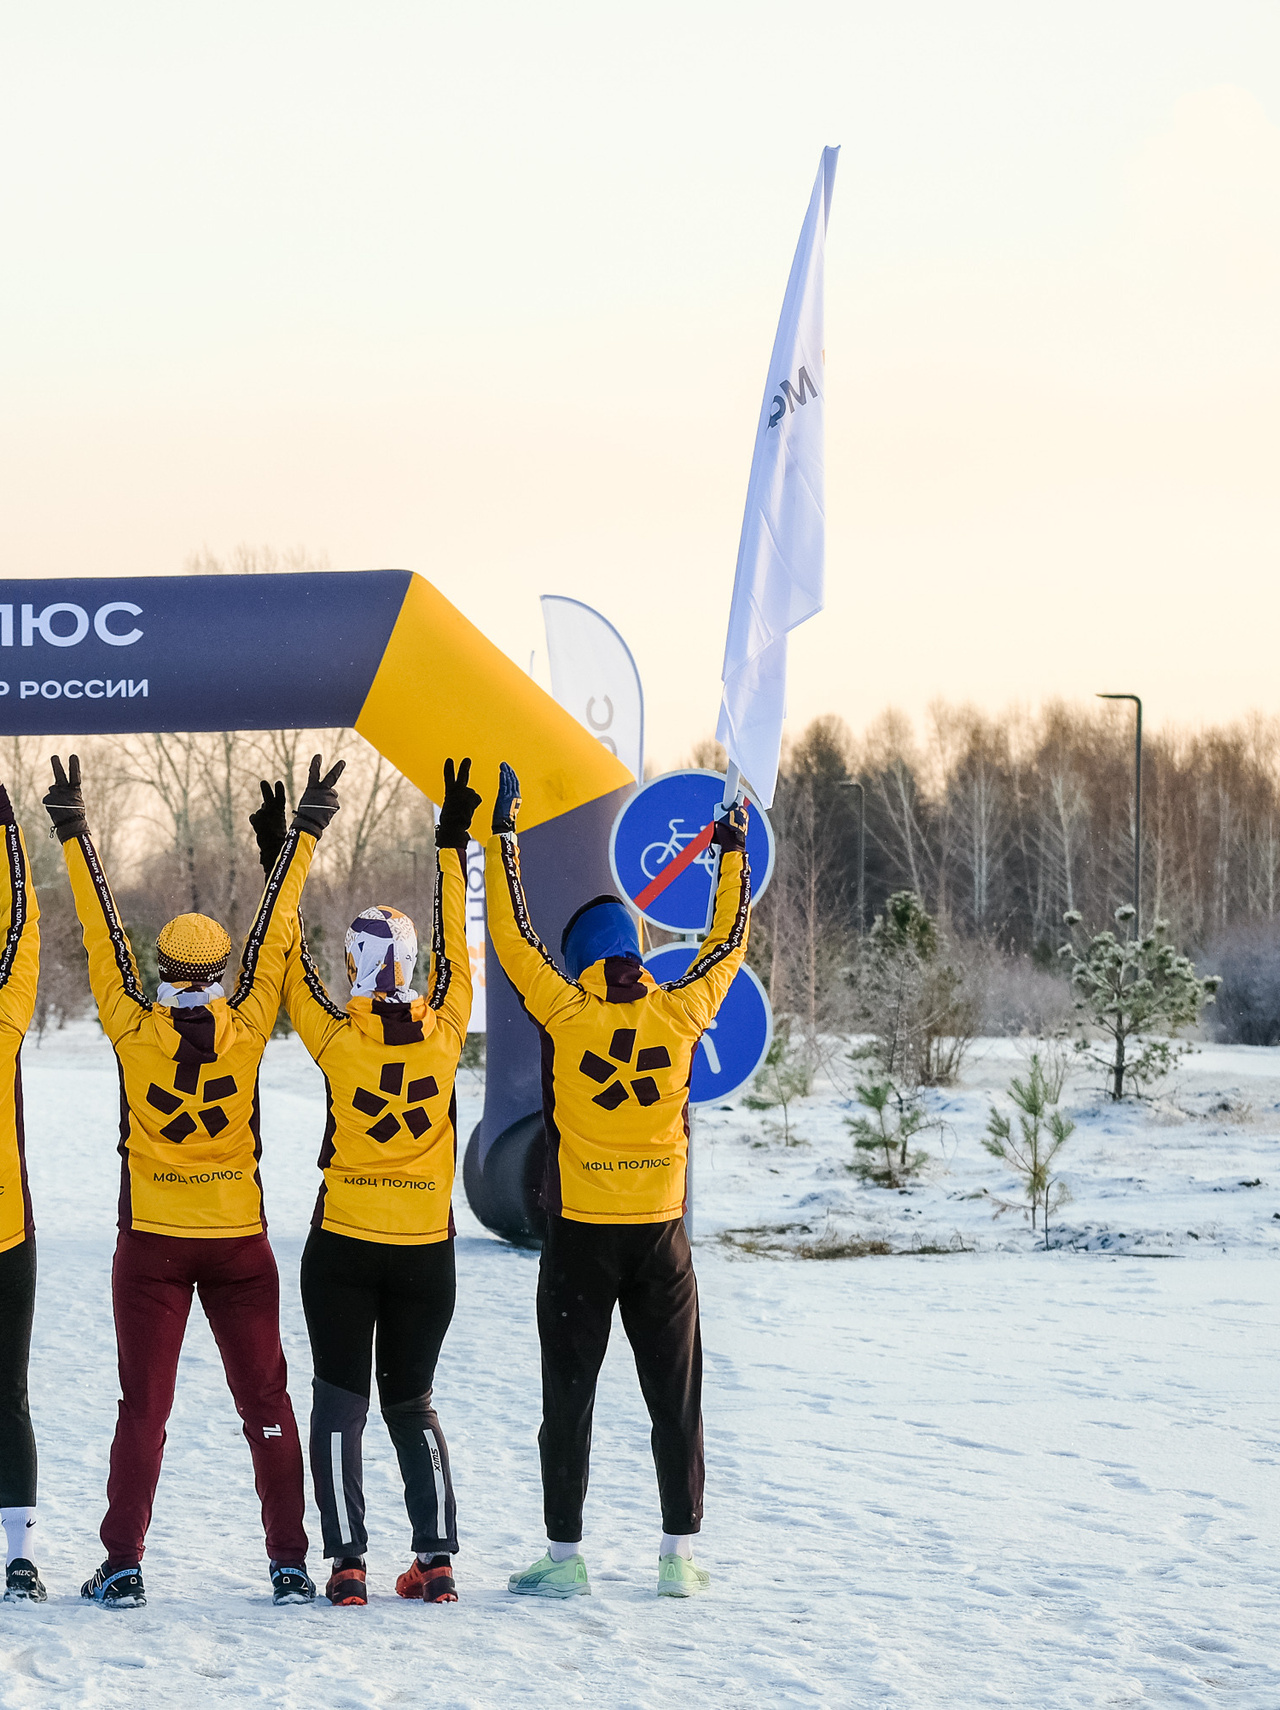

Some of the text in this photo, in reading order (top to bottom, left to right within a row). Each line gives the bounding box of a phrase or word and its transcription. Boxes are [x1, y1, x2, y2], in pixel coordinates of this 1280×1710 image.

[19, 678, 149, 699] РОССИИ
[581, 1157, 670, 1171] МФЦ ПОЛЮС
[154, 1170, 243, 1184] МФЦ ПОЛЮС
[344, 1177, 435, 1191] МФЦ ПОЛЮС
